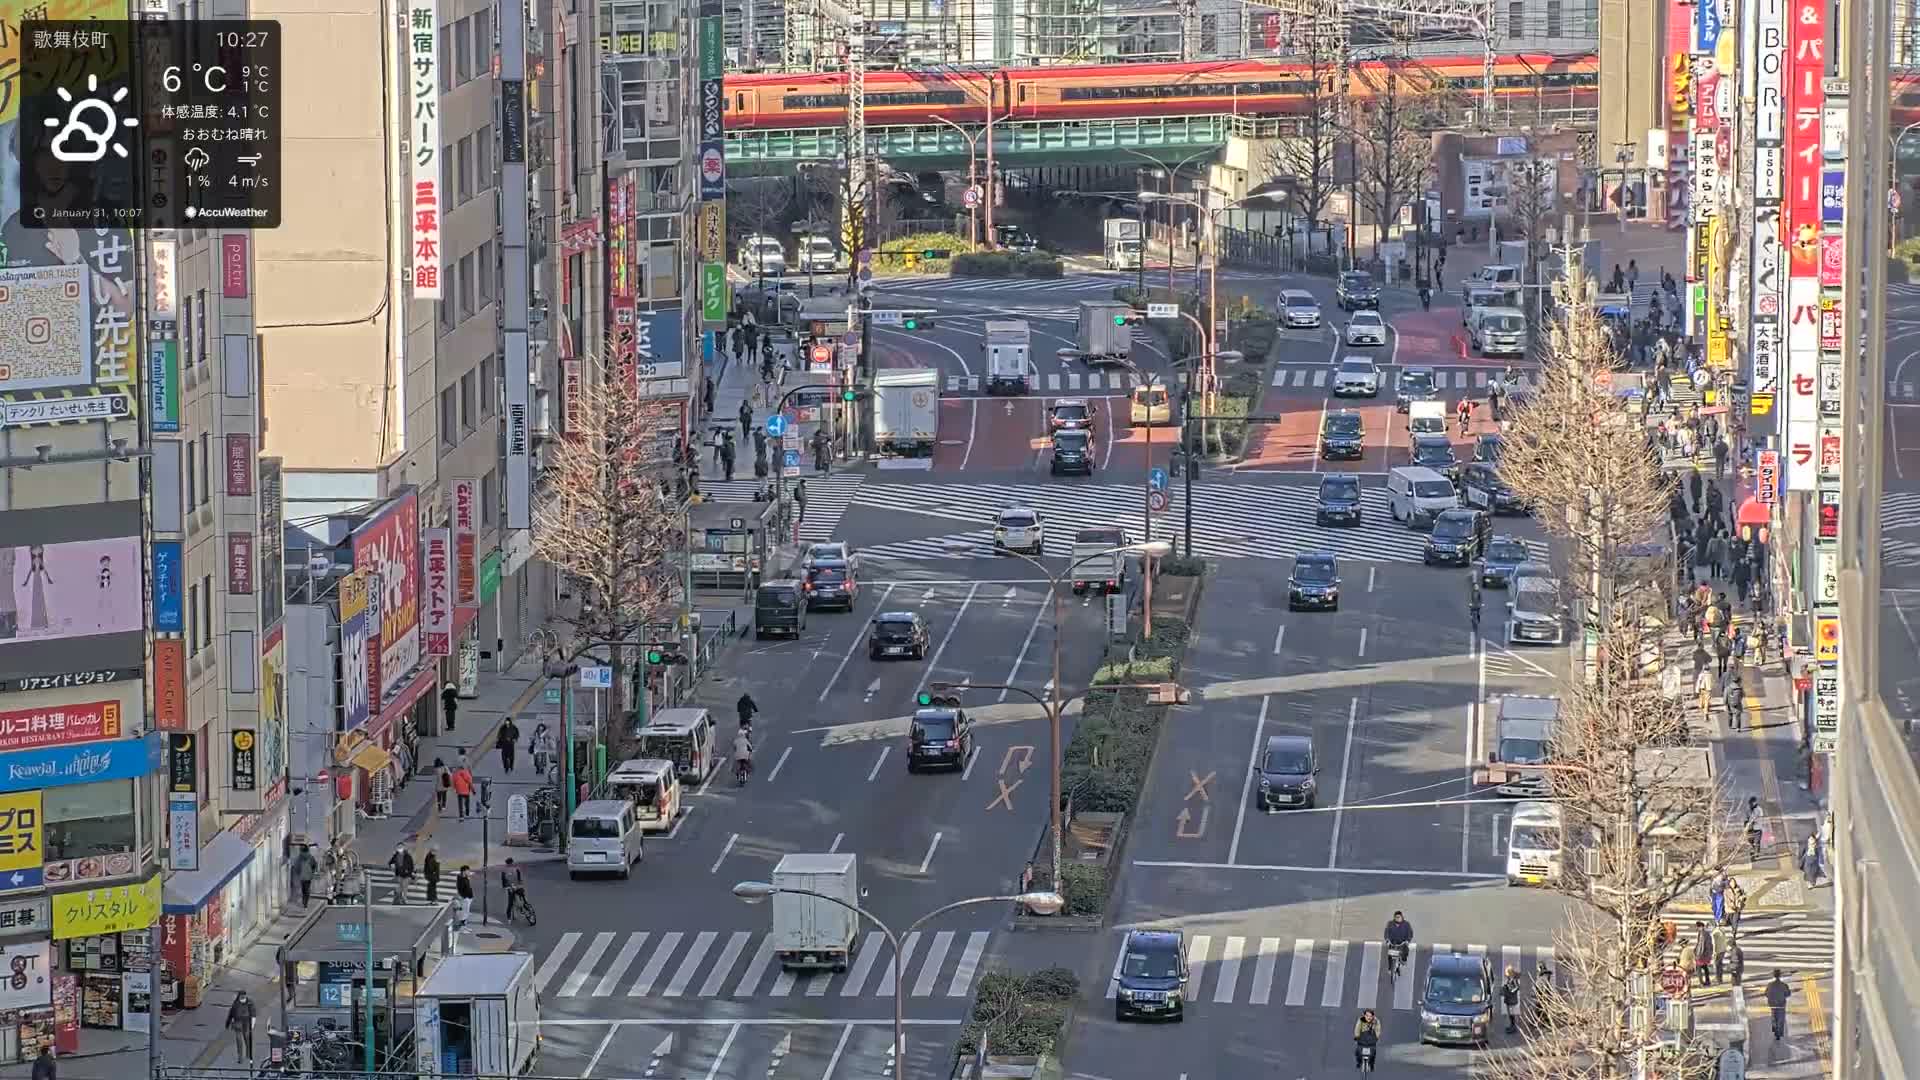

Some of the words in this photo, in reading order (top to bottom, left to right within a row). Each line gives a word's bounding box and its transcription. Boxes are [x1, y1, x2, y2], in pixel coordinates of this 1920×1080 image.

[411, 8, 436, 166] 新宿サンパーク
[1796, 6, 1824, 202] &パーティー
[415, 181, 437, 289] 三平本館
[91, 228, 130, 383] せい先生
[704, 271, 719, 312] レイク
[1756, 326, 1769, 379] 大衆酒場
[153, 351, 165, 411] FamilyMart
[1790, 304, 1818, 467] パセラ
[50, 401, 107, 416] たいせい先生
[430, 540, 446, 626] 三平ストア
[20, 671, 116, 691] リアエイドビジョン
[0, 808, 35, 830] プロ
[0, 908, 35, 928] 囲碁
[66, 900, 138, 924] クリスタル
[325, 988, 338, 1001] 12
